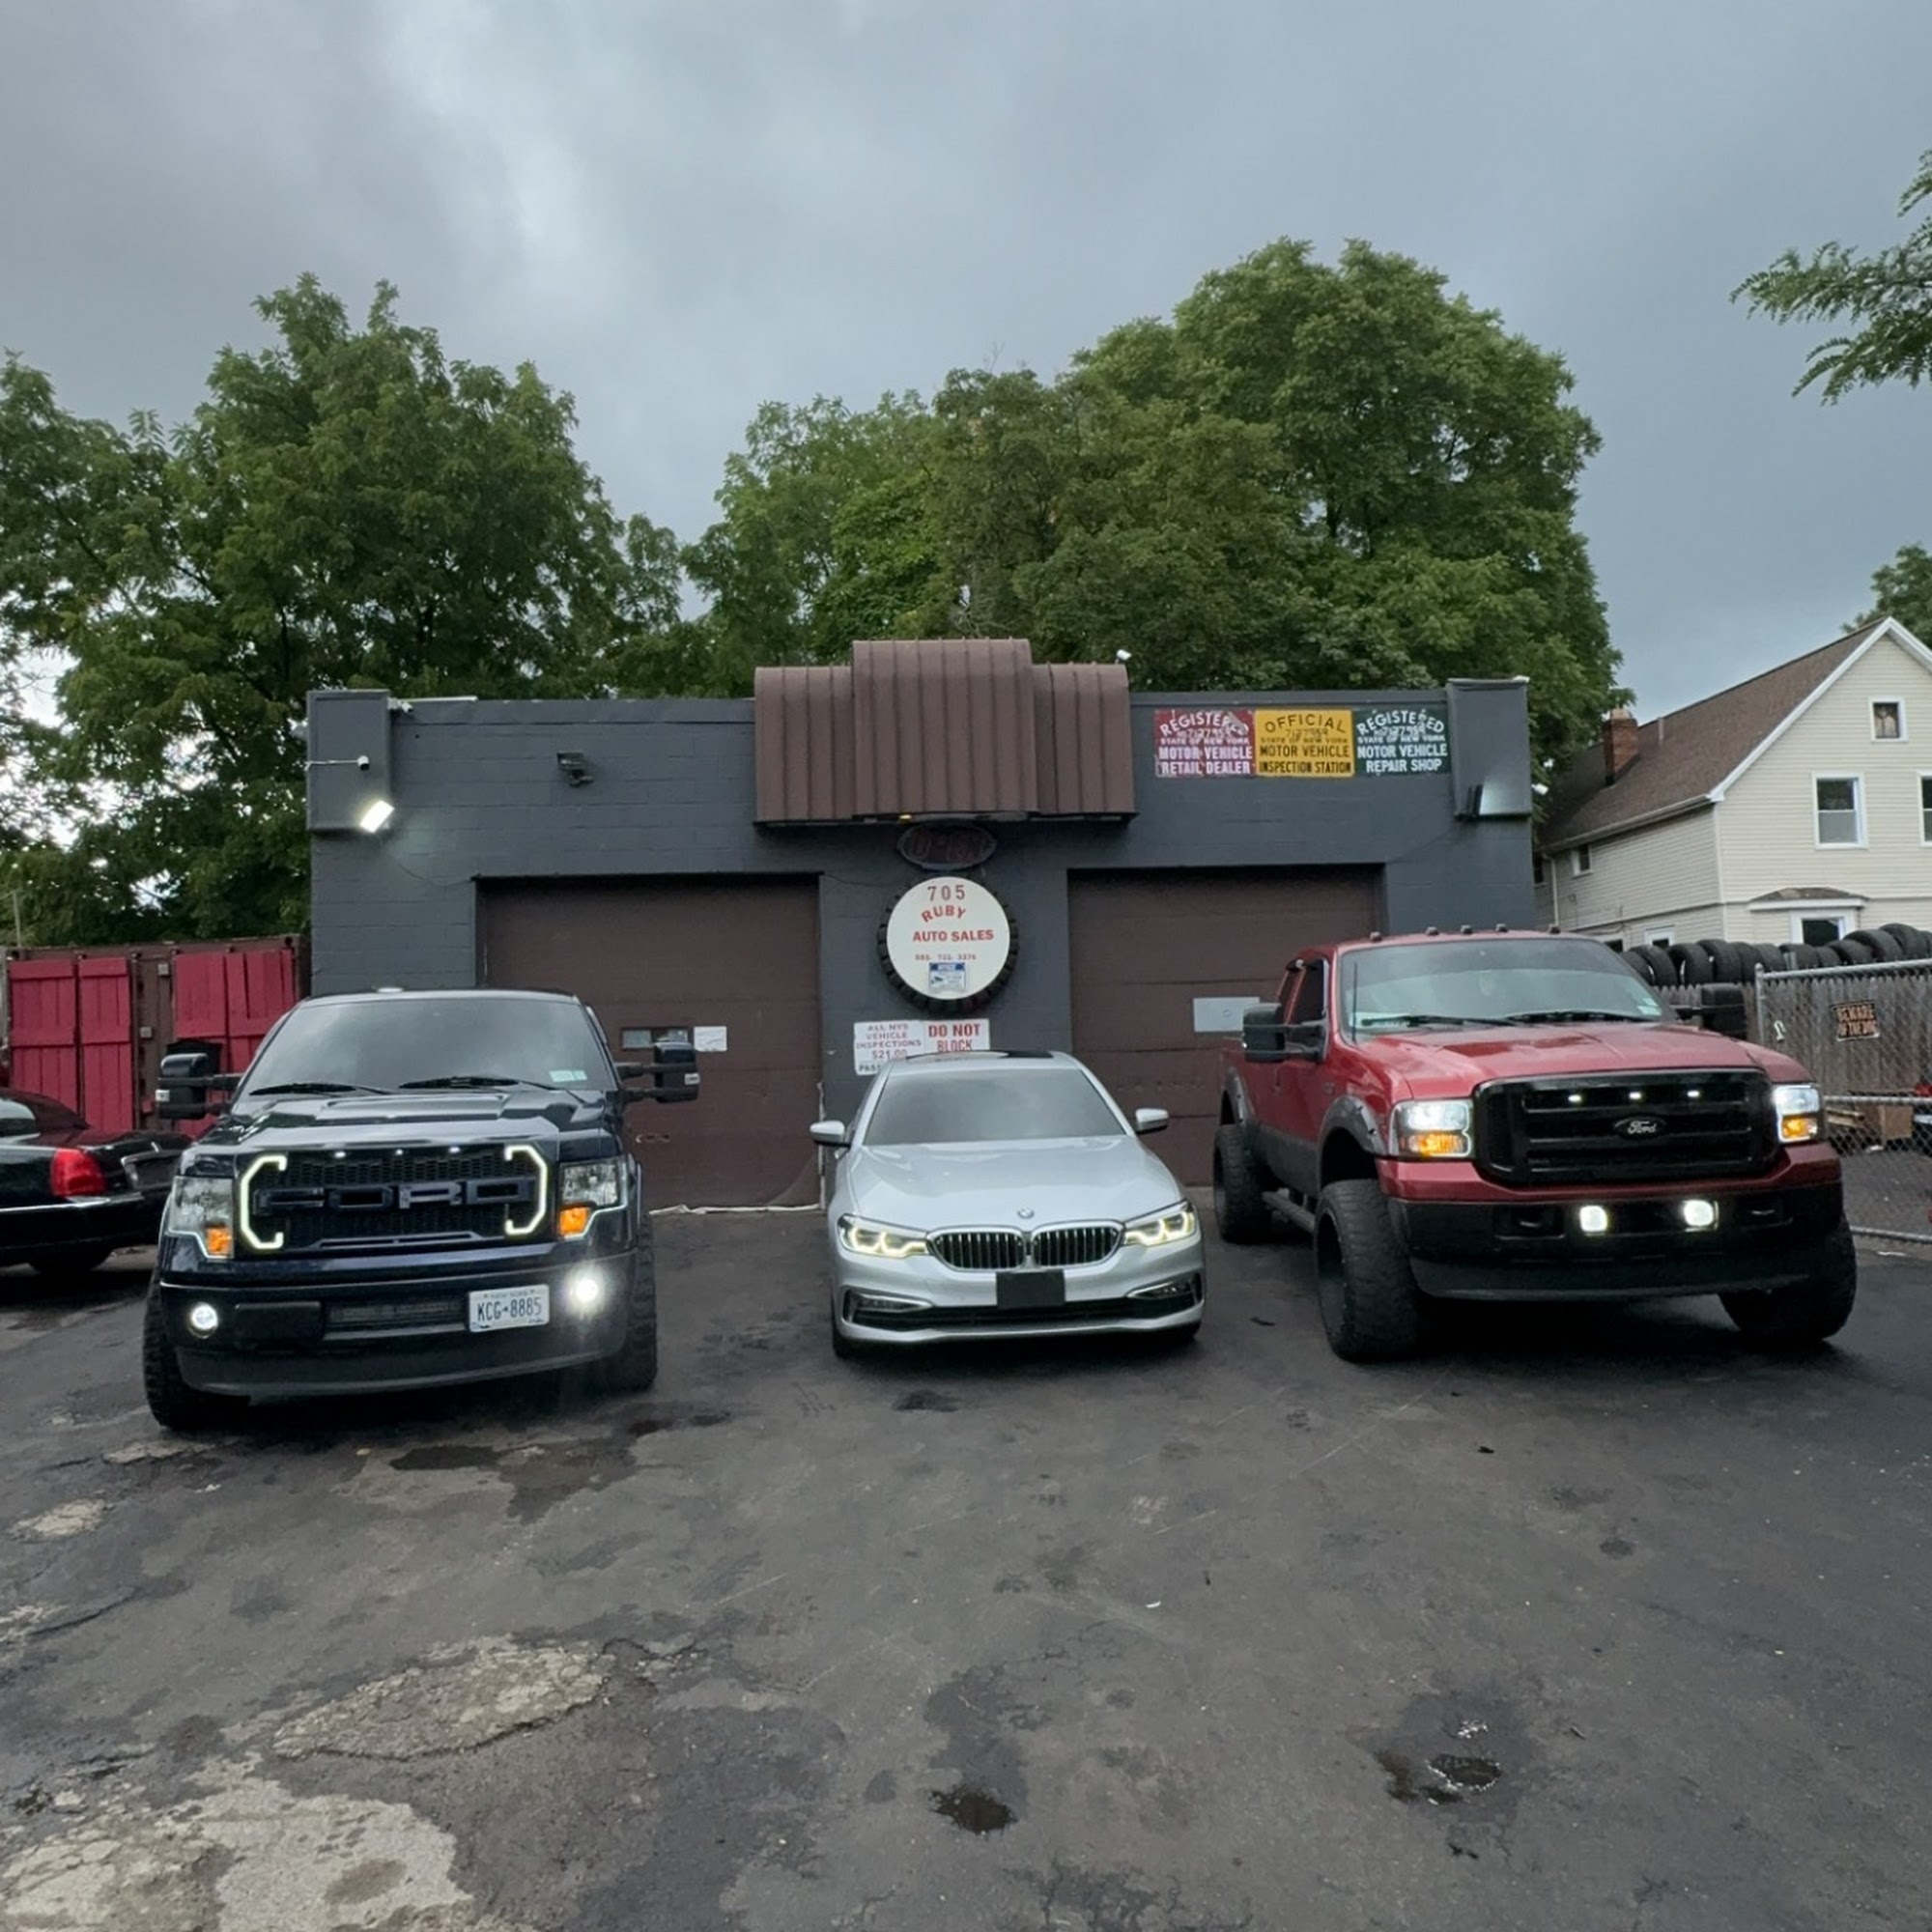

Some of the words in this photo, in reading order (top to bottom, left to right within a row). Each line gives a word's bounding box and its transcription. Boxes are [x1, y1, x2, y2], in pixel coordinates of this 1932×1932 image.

[1160, 711, 1250, 737] REGISTER
[1264, 714, 1346, 734] OFFICIAL
[1356, 710, 1445, 736] REGISTERED
[1159, 746, 1200, 760] MOTOR
[1204, 746, 1253, 760] VEHICLE
[1260, 745, 1298, 757] MOTOR
[1301, 745, 1350, 758] VEHICLE
[1357, 745, 1397, 759] MOTOR
[1399, 743, 1448, 757] VEHICLE
[1161, 761, 1201, 775] RETAIL
[1206, 761, 1251, 775] DEALER
[1259, 761, 1312, 773] INSPECTION
[1315, 761, 1351, 773] STATION
[1366, 759, 1407, 773] REPAIR
[1410, 758, 1442, 772] SHOP
[927, 884, 966, 902] 705
[921, 904, 966, 923] RUBY
[913, 930, 948, 942] AUTO
[951, 929, 994, 942] SALES
[866, 1032, 908, 1040] VEHICLE
[928, 1024, 948, 1037] DO
[952, 1023, 980, 1037] NOT
[856, 1038, 922, 1050] INSPECTIONS
[937, 1039, 973, 1053] BLOCK
[1627, 1121, 1658, 1134] Ford
[252, 1176, 536, 1217] FORD
